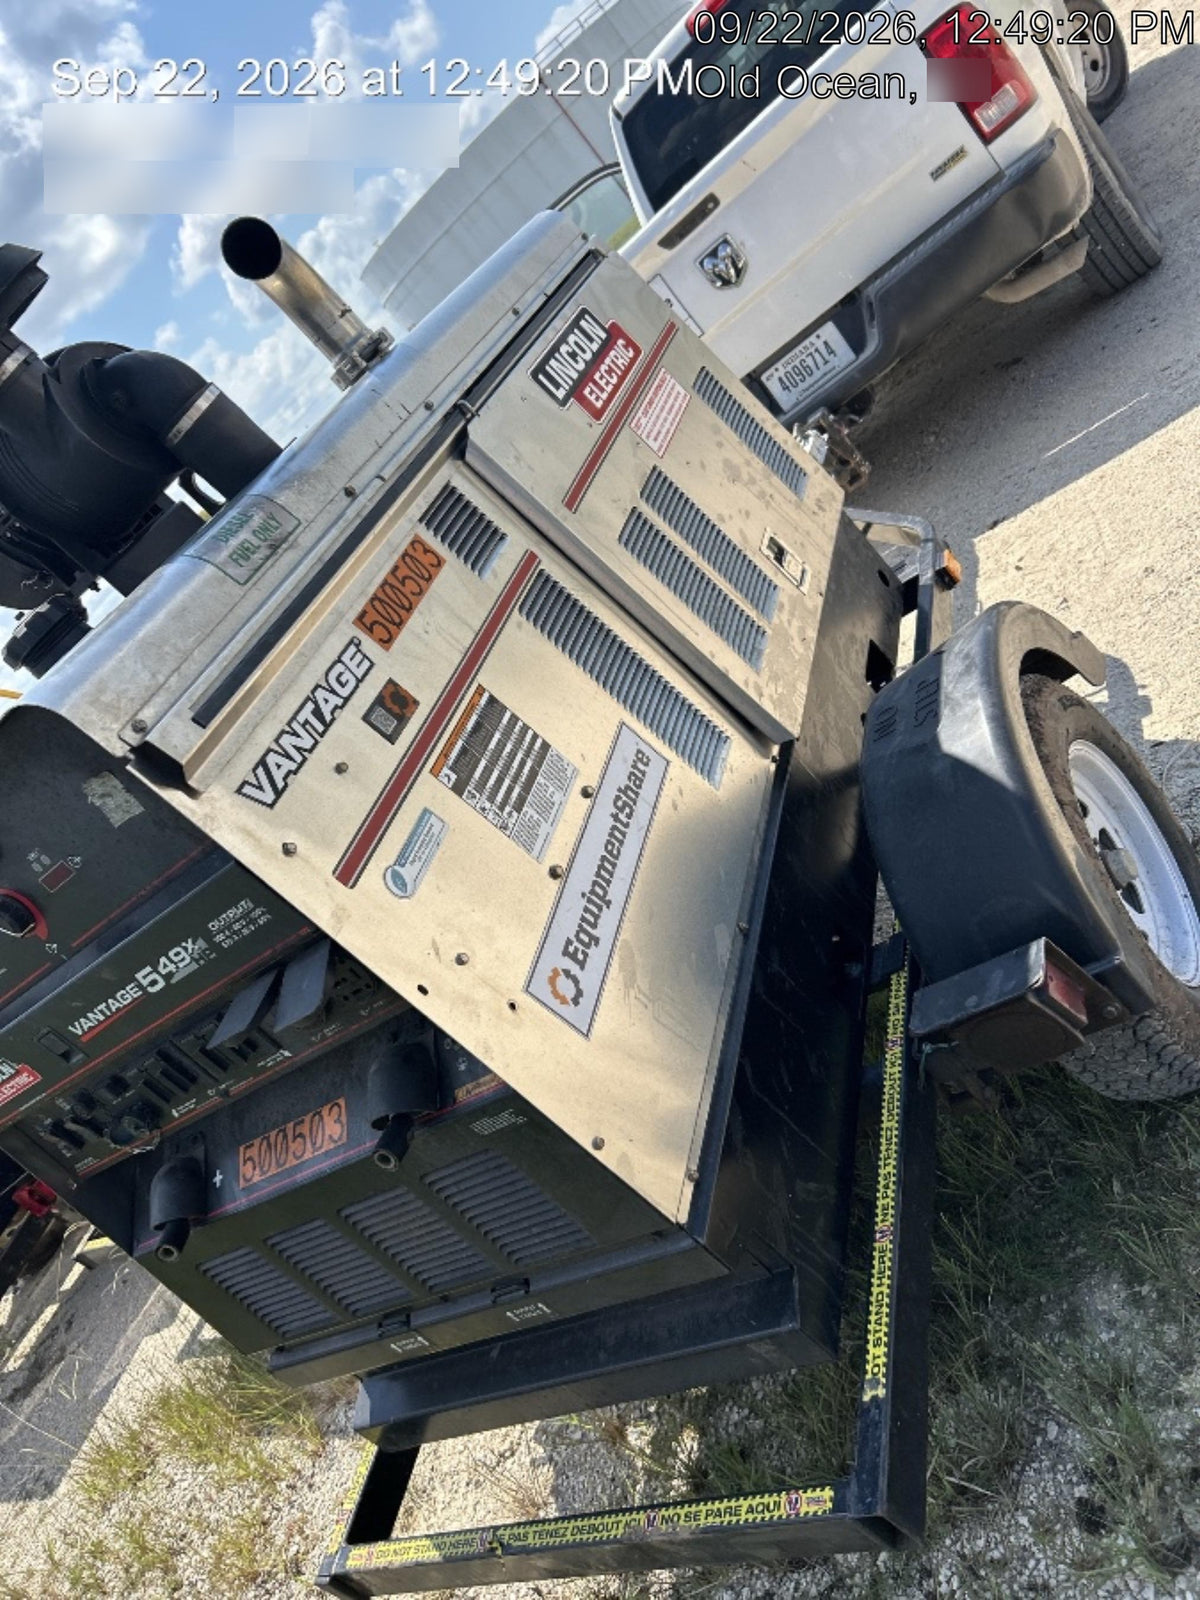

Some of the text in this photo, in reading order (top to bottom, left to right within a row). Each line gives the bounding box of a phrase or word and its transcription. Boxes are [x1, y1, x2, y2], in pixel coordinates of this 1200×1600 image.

[536, 312, 608, 400] LINCOLN
[581, 336, 637, 409] ELECTRIC
[775, 340, 837, 394] 4096714
[228, 511, 283, 569] FUEL ONLY
[357, 537, 443, 646] 500503
[873, 705, 899, 742] NO
[561, 747, 651, 971] EquipmentShare
[67, 982, 143, 1036] VANTAGE
[885, 1070, 897, 1121] DEBOUT
[242, 1103, 346, 1182] 500503
[883, 1126, 894, 1169] TENEZ
[881, 1170, 891, 1199] PAS
[881, 1202, 890, 1222] NE
[877, 1243, 888, 1286] HERE
[872, 1290, 884, 1347] STAND
[507, 1530, 529, 1545] PAS
[531, 1525, 567, 1542] TENEZ
[569, 1519, 621, 1537] DEBOUT
[659, 1498, 782, 1526] NO SE PARE AQUI
[376, 1547, 389, 1559] DO
[390, 1544, 412, 1557] NOT
[412, 1539, 447, 1555] STAND
[448, 1536, 477, 1551] HERE
